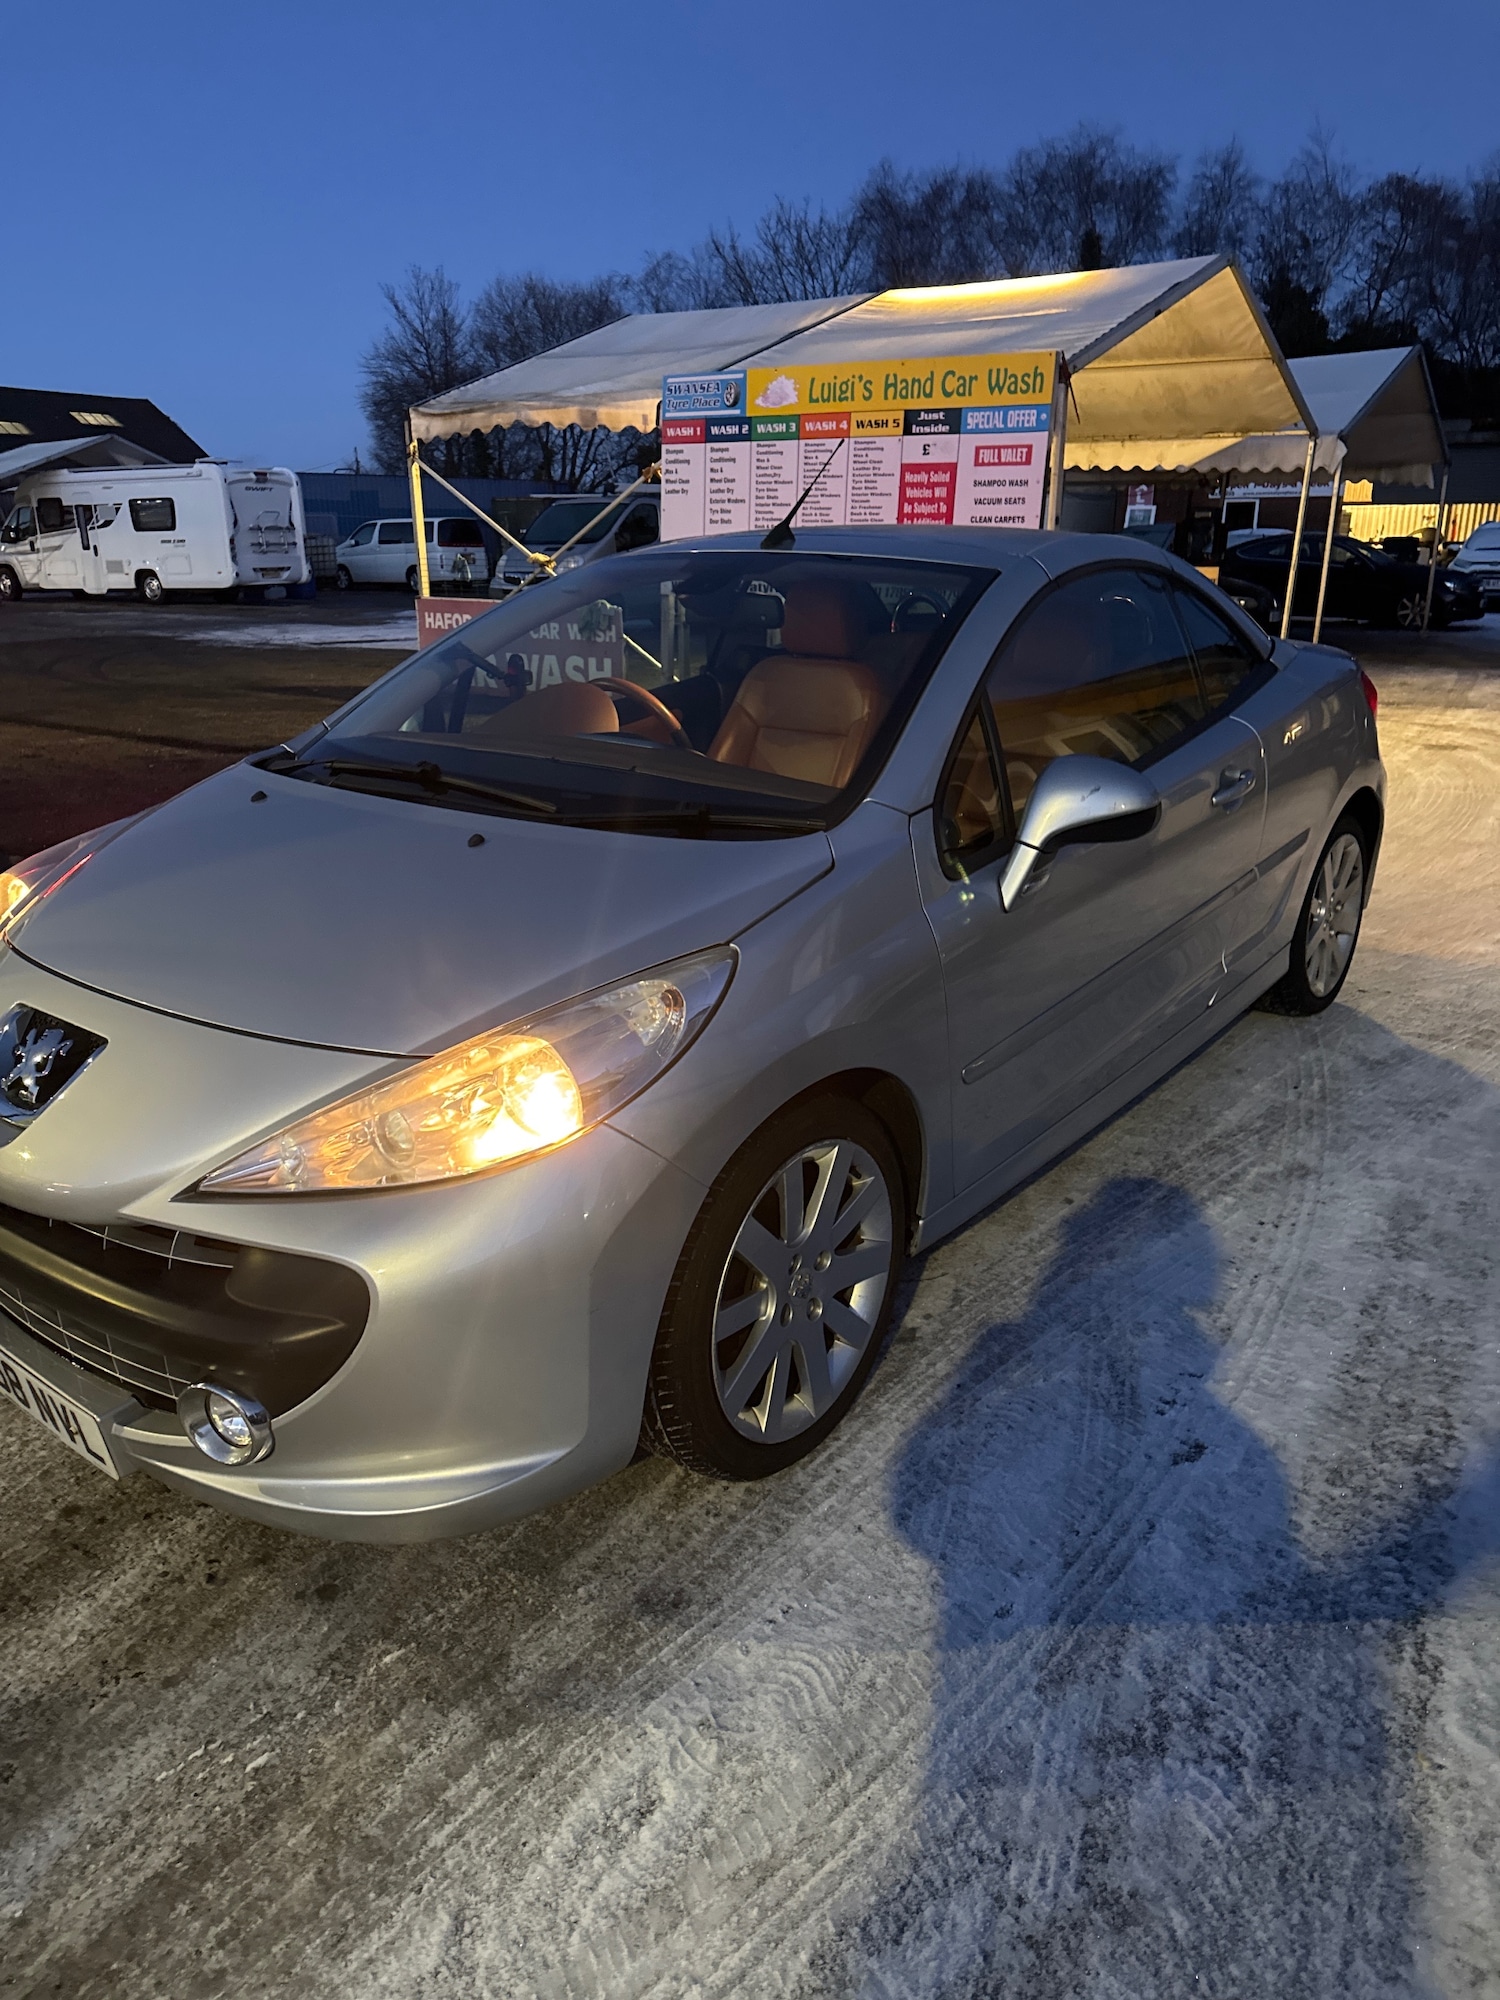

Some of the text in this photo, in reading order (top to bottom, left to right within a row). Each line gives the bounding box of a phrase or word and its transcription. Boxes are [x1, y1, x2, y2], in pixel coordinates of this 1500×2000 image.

[666, 381, 721, 396] SWANSEA
[808, 365, 1045, 404] Luigi's Hand Car Wash
[666, 396, 720, 411] Tyre Place
[917, 410, 945, 421] Just
[966, 409, 1037, 429] SPECIAL OFFER
[710, 424, 749, 435] WASH 2
[756, 422, 796, 433] WASH 3
[805, 420, 848, 432] WASH 4
[856, 418, 900, 430] WASH 5
[911, 423, 950, 434] Inside
[667, 426, 701, 437] WASH 1
[922, 443, 930, 456] £
[979, 447, 1028, 463] FULL VALET
[905, 471, 950, 485] Heavily Soiled
[973, 479, 1029, 488] SHAMPOO WASH
[905, 486, 947, 498] Vehicles Will
[974, 497, 1026, 505] VACUUM SEATS
[903, 502, 947, 515] Be Subject To
[567, 623, 616, 643] WSH
